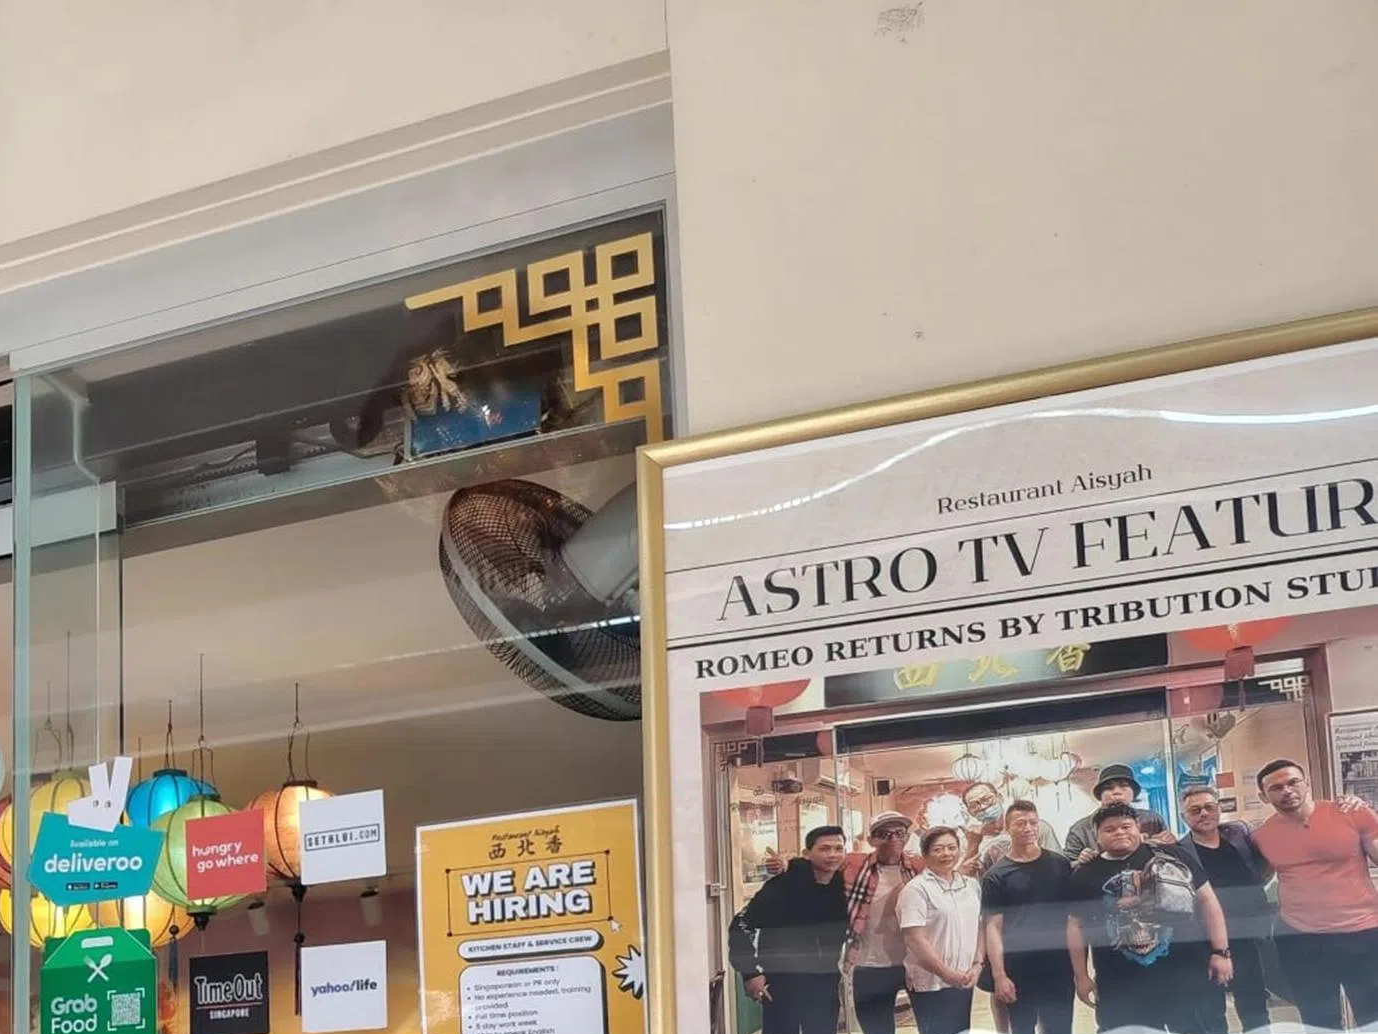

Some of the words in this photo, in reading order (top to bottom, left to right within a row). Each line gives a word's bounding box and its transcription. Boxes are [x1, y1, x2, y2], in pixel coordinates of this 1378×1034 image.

[936, 479, 1063, 515] Restaurant
[1070, 463, 1152, 493] Aisyah
[716, 546, 938, 621] ASTRO
[958, 526, 1049, 584] TV
[1070, 477, 1378, 569] FEATUR
[694, 645, 813, 679] ROMEO
[824, 621, 986, 663] RETURNS
[999, 612, 1045, 640] BY
[1055, 581, 1272, 631] TRIBUTION
[1287, 566, 1378, 601] STU
[70, 840, 106, 848] Available
[307, 828, 377, 847] SETHLUI.COM
[192, 841, 242, 857] hungry
[489, 835, 563, 860] 西北香
[44, 853, 142, 873] deliveroo
[197, 859, 213, 872] go
[216, 853, 258, 867] where
[461, 870, 515, 897] WE
[524, 860, 596, 892] ARE
[468, 888, 592, 924] HIRING
[468, 943, 502, 953] KITCHEN
[504, 941, 527, 950] STAFF
[536, 938, 567, 947] SERVICE
[569, 935, 593, 944] CREW
[311, 979, 378, 997] yahoo!life
[474, 982, 521, 992] Singaporean
[51, 993, 98, 1015] Grab
[210, 1008, 249, 1020] SINGAPORE
[508, 1010, 538, 1018] position
[51, 1014, 98, 1034] Food
